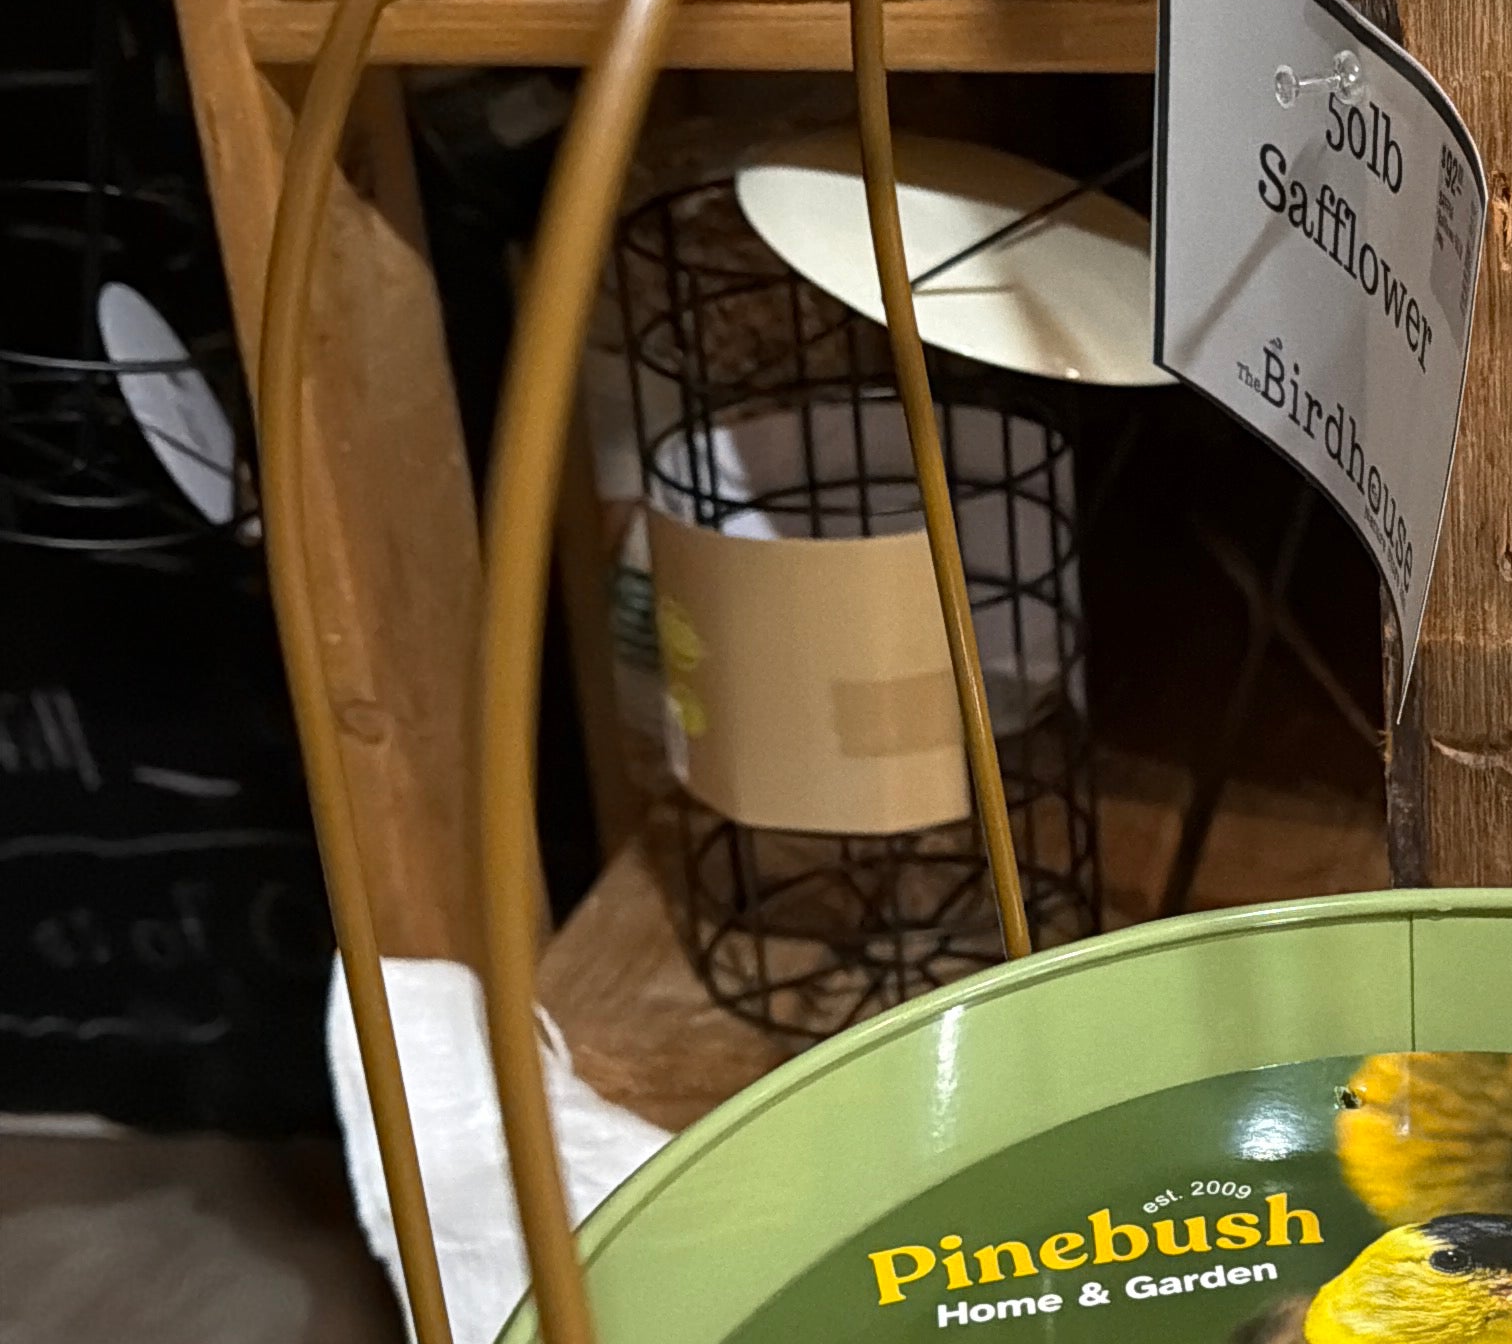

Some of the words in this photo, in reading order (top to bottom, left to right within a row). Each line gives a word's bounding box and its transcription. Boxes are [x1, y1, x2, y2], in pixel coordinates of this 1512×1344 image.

[1258, 143, 1433, 373] Safflower
[1237, 361, 1261, 394] The
[1261, 346, 1412, 594] Birdhouse
[867, 1191, 1325, 1307] Pinebush
[1143, 1187, 1183, 1214] est.
[1189, 1179, 1252, 1200] 2009
[936, 1290, 1063, 1329] Home
[1078, 1281, 1110, 1308] &
[1124, 1261, 1278, 1299] Garden
